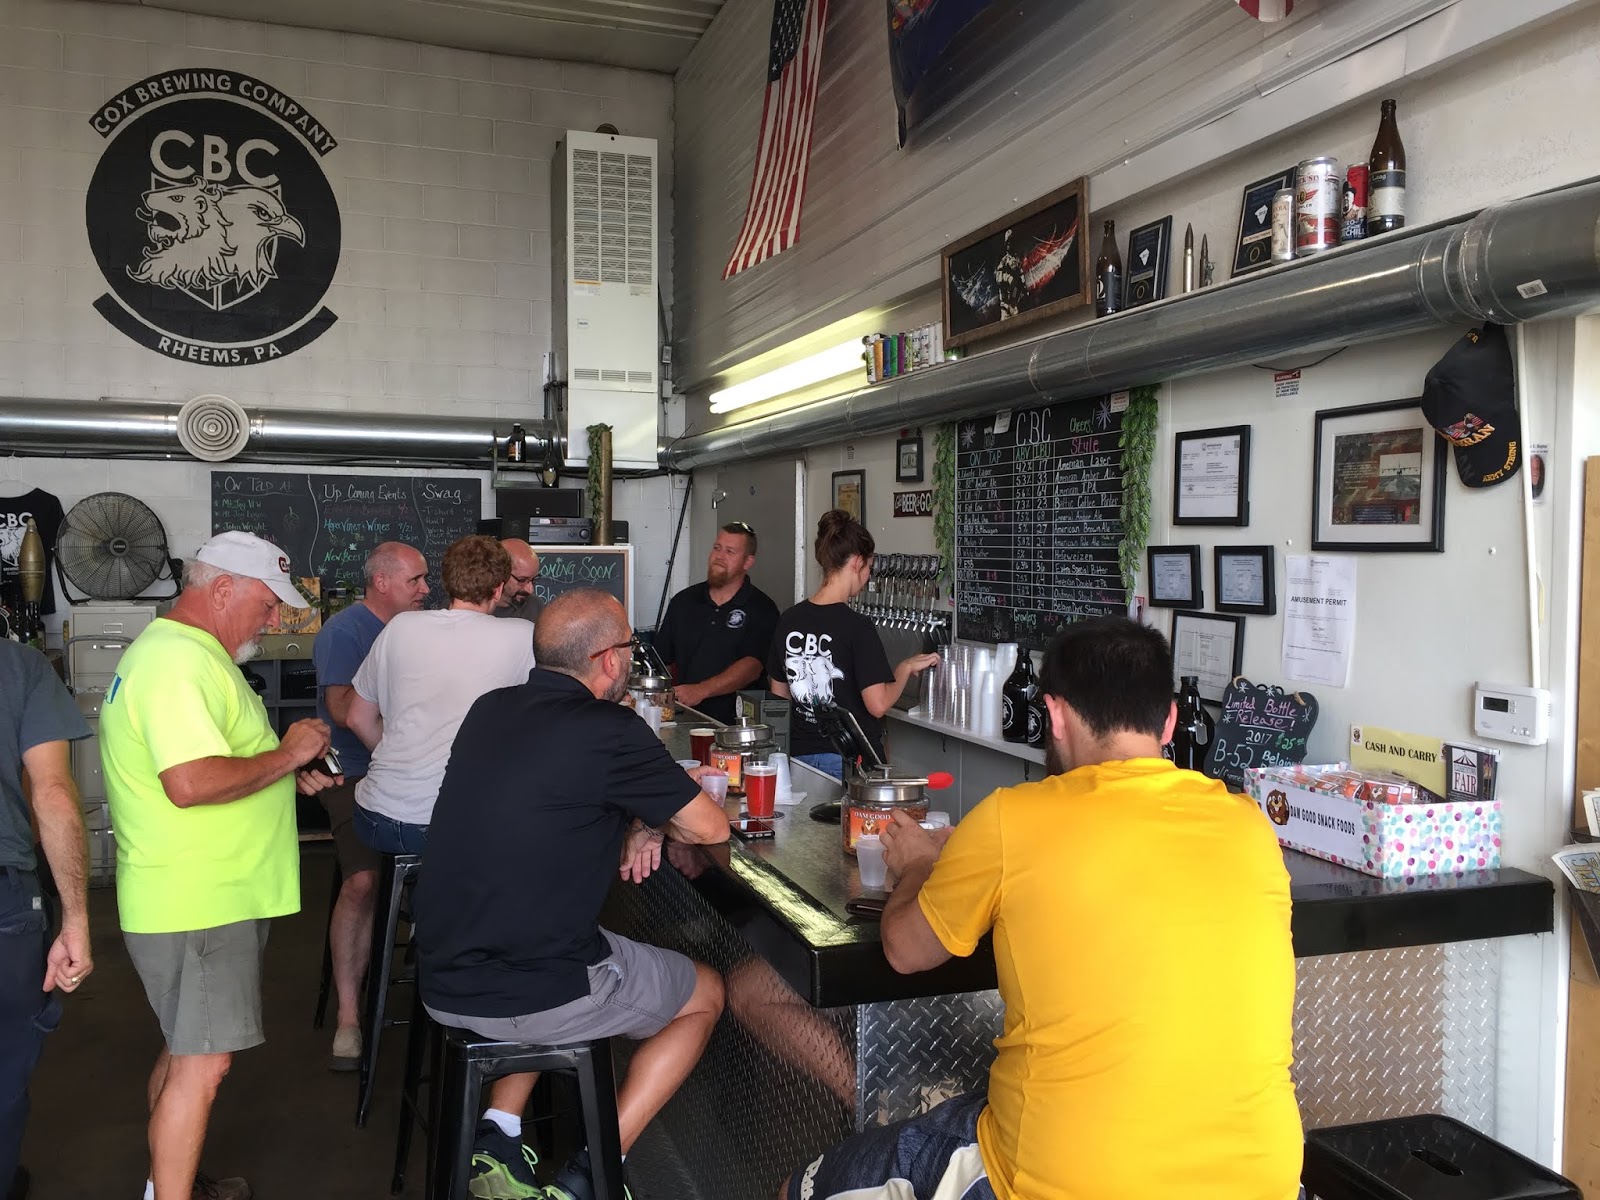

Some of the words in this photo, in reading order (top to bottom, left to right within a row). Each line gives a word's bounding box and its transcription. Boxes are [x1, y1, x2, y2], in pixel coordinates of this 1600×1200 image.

[93, 95, 136, 135] COX
[136, 73, 232, 105] BREWING
[238, 79, 337, 153] COMPANY
[150, 129, 280, 186] CBC
[158, 337, 250, 366] RHEEMS,
[253, 343, 282, 362] PA
[1016, 407, 1051, 446] CBC
[1069, 407, 1095, 433] Cheers!
[1015, 446, 1031, 461] ABV
[1033, 443, 1051, 459] IBU
[1071, 436, 1100, 456] Style
[969, 452, 982, 467] ON
[986, 450, 1002, 465] TAP
[1056, 458, 1084, 470] American
[1090, 454, 1111, 467] Lager
[1482, 469, 1505, 483] ARMY
[1503, 441, 1517, 471] STRONG
[246, 476, 274, 492] Tap
[1036, 472, 1048, 484] 33
[1082, 481, 1098, 494] IPA
[323, 484, 342, 503] Up
[347, 484, 376, 504] Coming
[378, 484, 408, 500] Events
[422, 483, 462, 504] Swag
[986, 490, 998, 500] IPA
[902, 494, 918, 514] BEER
[0, 512, 32, 528] CBC
[366, 518, 390, 534] Wines
[1036, 524, 1048, 534] 27
[1054, 524, 1080, 534] American
[1100, 522, 1110, 532] Ale
[1054, 538, 1078, 547] American
[1054, 550, 1094, 561] Hefeweizen
[578, 556, 617, 582] Soon
[1290, 596, 1324, 605] AMUSEMENT
[1325, 598, 1348, 606] PERMIT
[785, 631, 832, 657] CBC
[1225, 693, 1256, 710] Limited
[1264, 698, 1298, 717] Bottle
[1245, 730, 1272, 744] 2017
[1214, 738, 1254, 769] B-52
[1365, 740, 1386, 754] CASH
[1388, 744, 1406, 757] AND
[1408, 748, 1438, 763] CARRY
[1454, 772, 1477, 795] FAIR
[1290, 806, 1300, 818] DAM
[1302, 808, 1316, 824] GOOD
[1318, 812, 1336, 829] SNACK
[1336, 818, 1356, 836] FOODS
